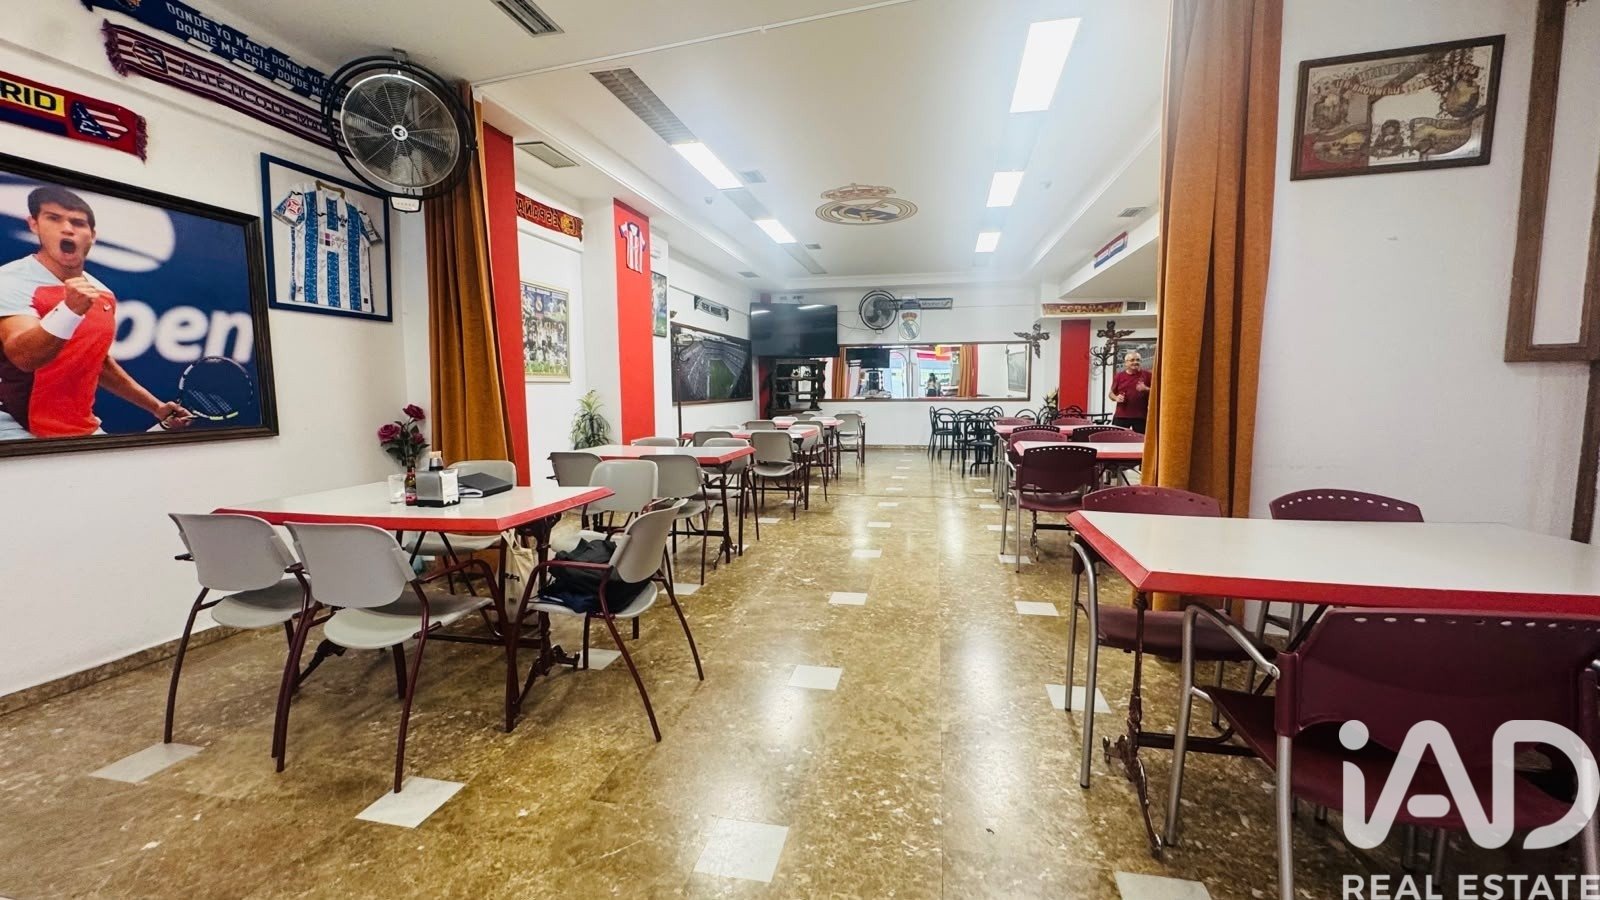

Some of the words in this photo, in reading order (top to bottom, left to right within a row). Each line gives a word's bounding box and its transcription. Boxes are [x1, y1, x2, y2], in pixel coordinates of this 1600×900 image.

[166, 2, 211, 32] DONDE
[214, 25, 232, 41] YO
[271, 54, 305, 77] DONDE
[307, 73, 320, 84] YO
[176, 20, 217, 47] DONDE
[221, 41, 239, 58] ME
[277, 69, 309, 91] DONDE
[0, 80, 57, 111] RID
